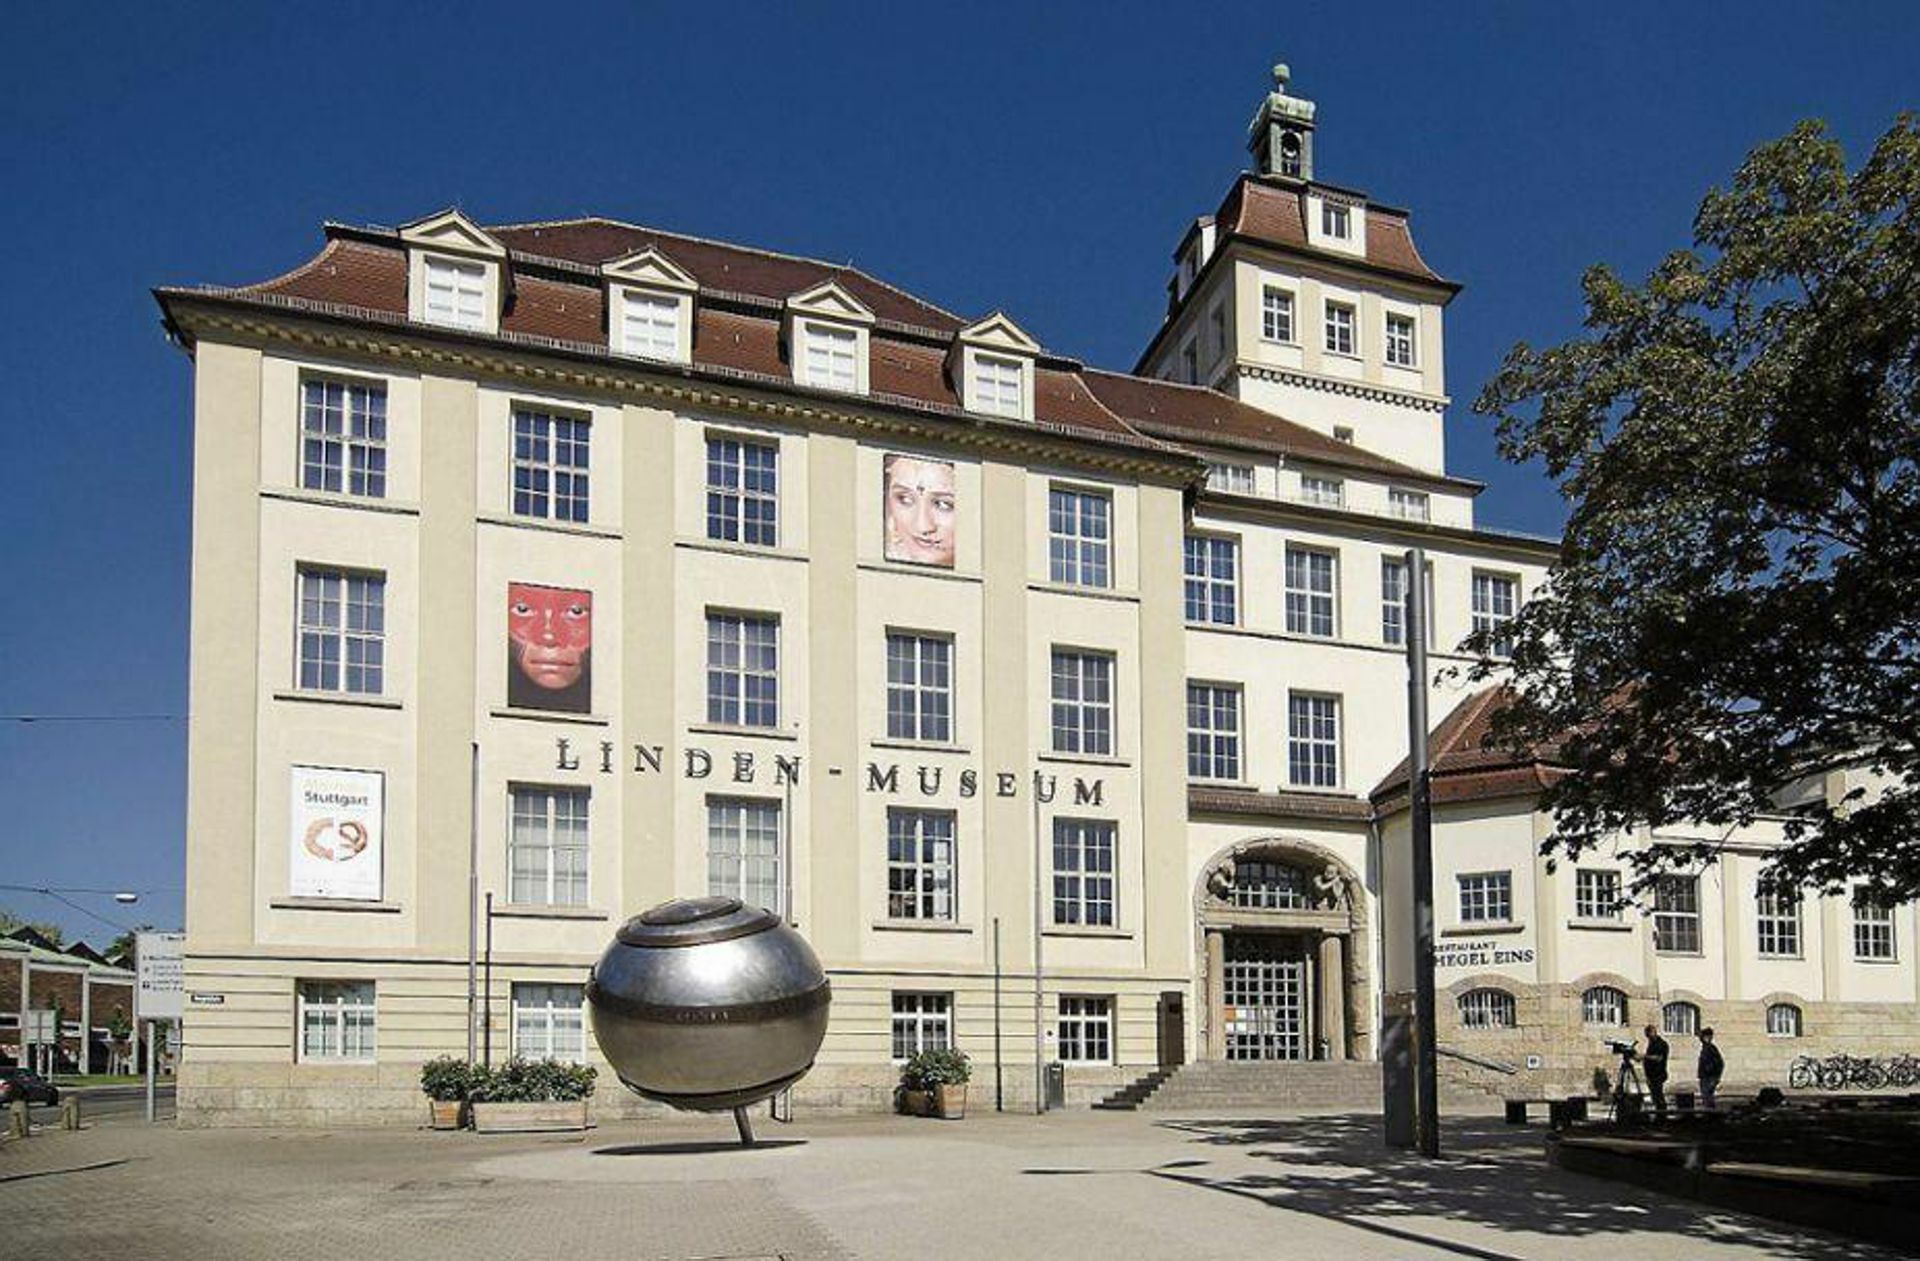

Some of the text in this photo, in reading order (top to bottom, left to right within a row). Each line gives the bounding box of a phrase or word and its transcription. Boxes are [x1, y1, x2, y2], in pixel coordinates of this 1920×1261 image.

[304, 791, 368, 807] Stuttgart
[1434, 949, 1534, 966] HEGEL EINS
